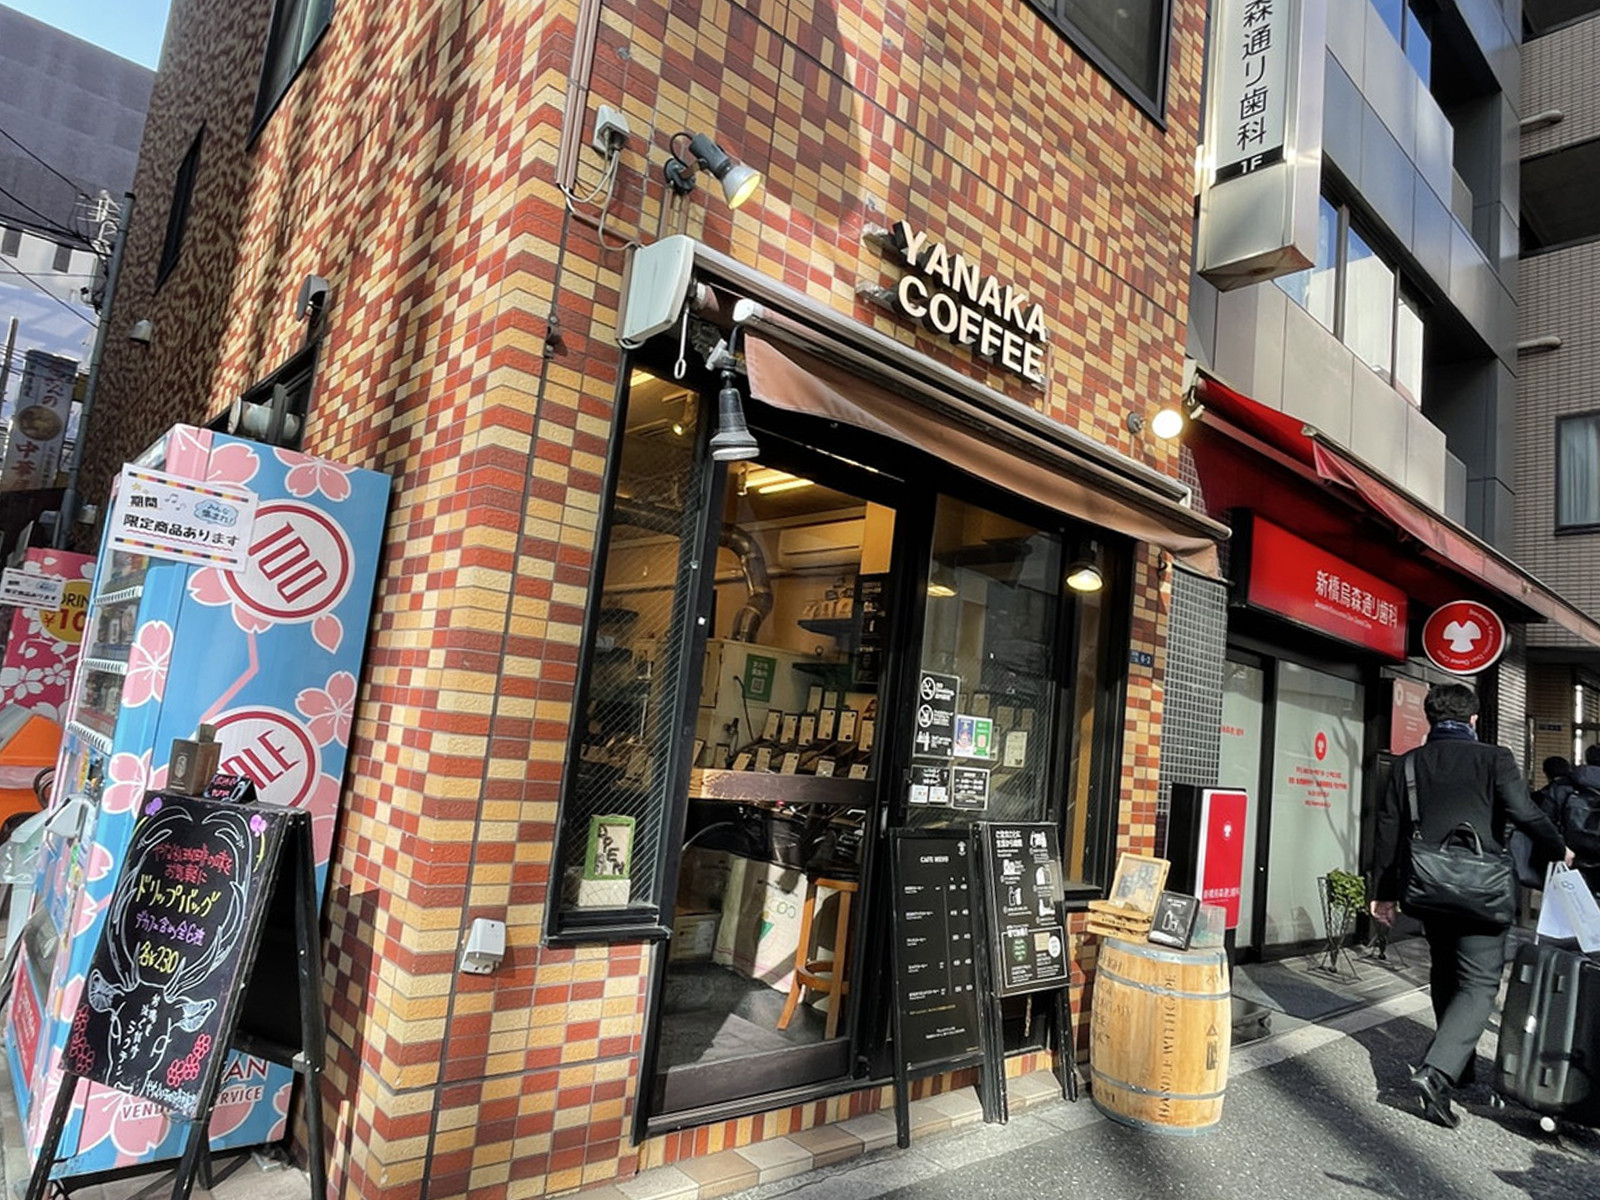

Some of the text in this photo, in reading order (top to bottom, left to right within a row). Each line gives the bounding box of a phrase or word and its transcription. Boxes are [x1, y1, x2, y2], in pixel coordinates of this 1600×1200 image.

[1240, 154, 1264, 174] 1F
[900, 219, 1047, 343] YANAKA
[898, 274, 1044, 384] COFFEE
[130, 494, 158, 509] 期間
[122, 512, 240, 547] 限定商品あります
[135, 874, 222, 917] ドリップバッグ
[220, 1086, 262, 1105] RVICE
